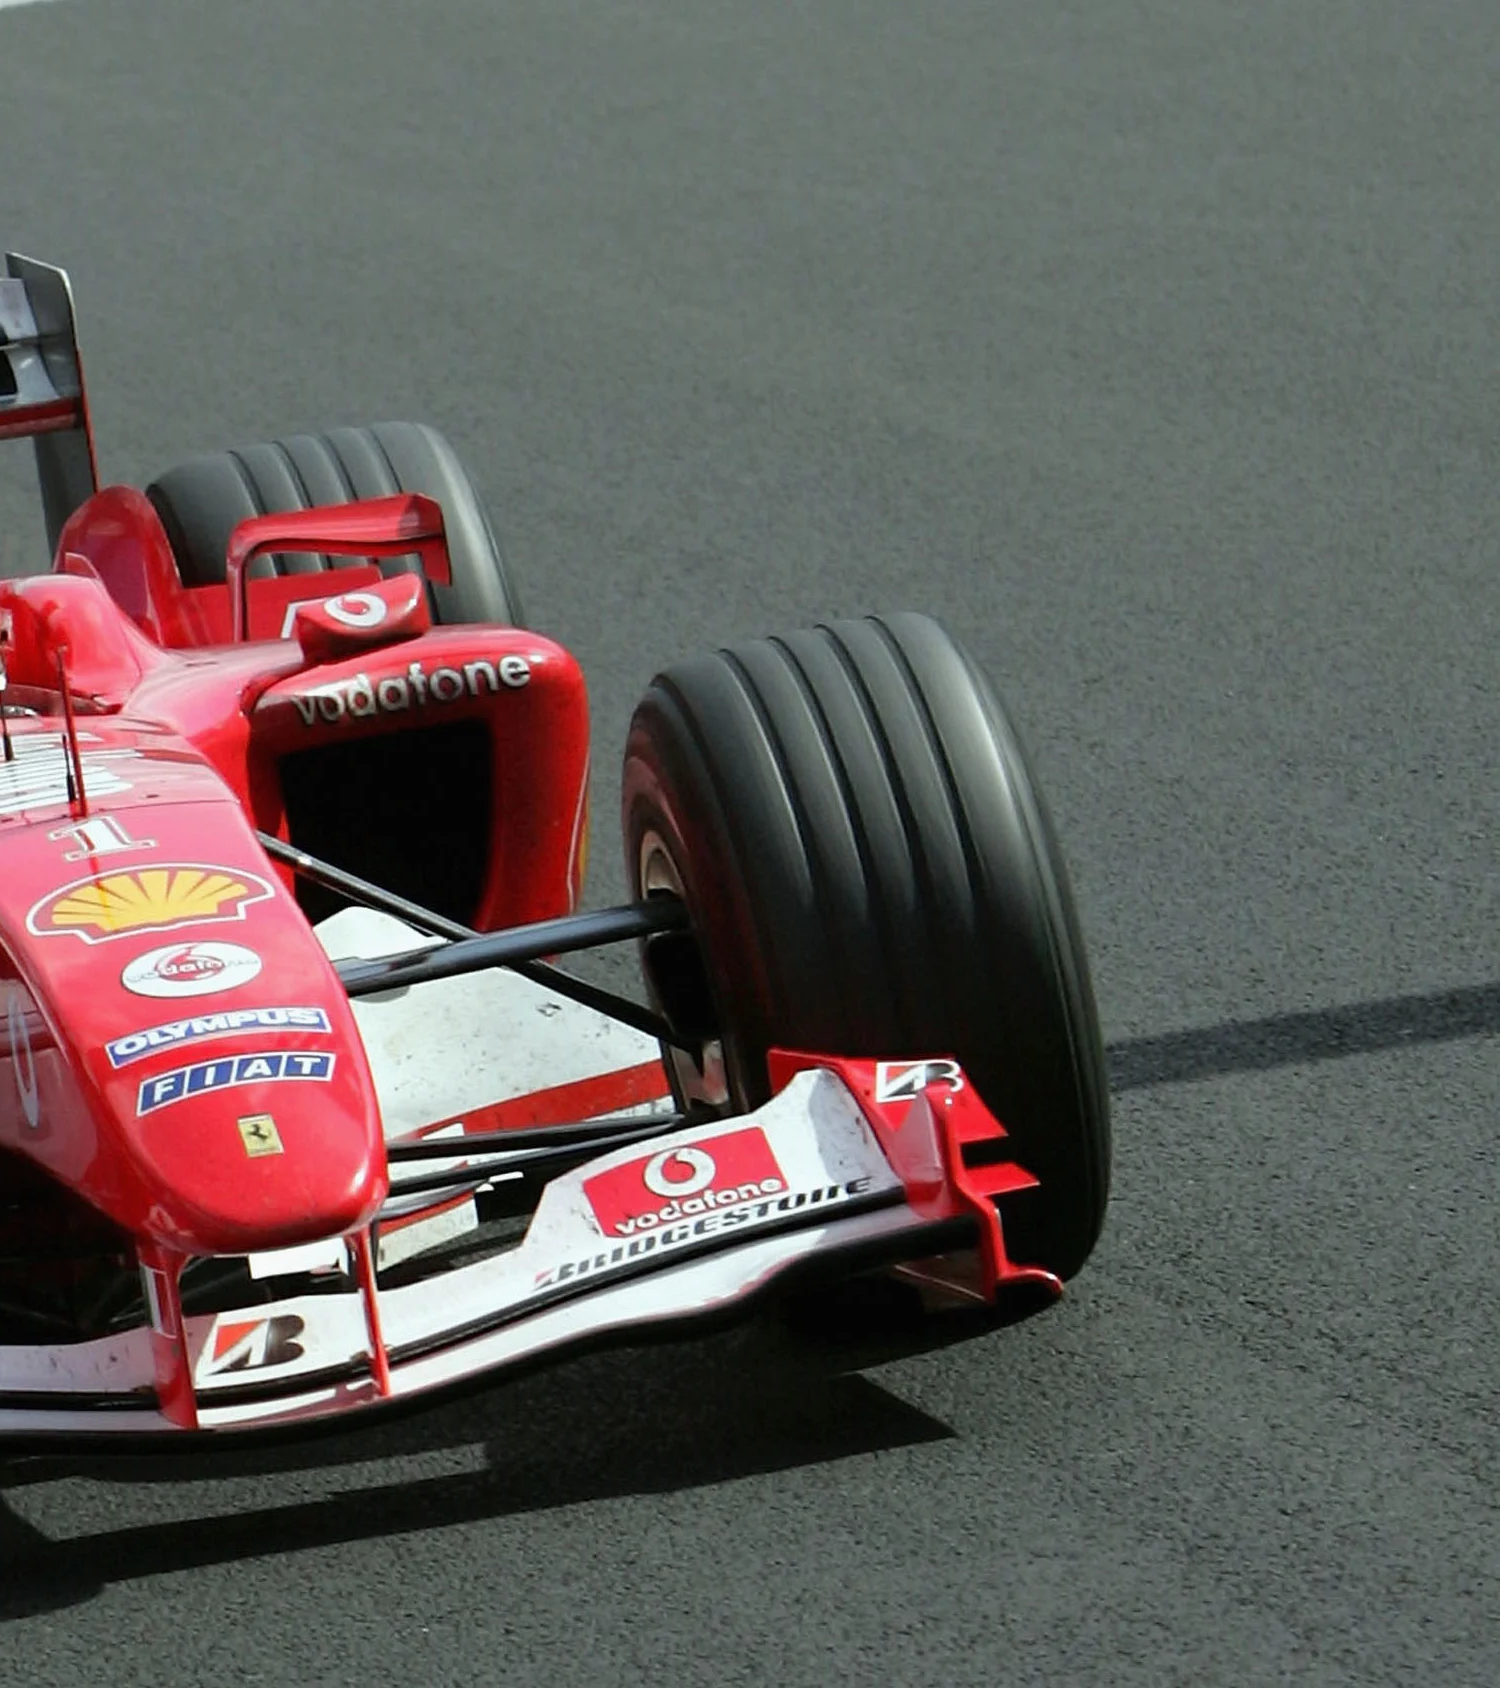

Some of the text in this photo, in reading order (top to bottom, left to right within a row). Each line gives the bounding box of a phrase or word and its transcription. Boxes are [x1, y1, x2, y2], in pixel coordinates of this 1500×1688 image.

[290, 655, 531, 725] vodafone
[49, 815, 157, 861] 1
[113, 1007, 320, 1057] OLYMPUS
[153, 1056, 322, 1104] FIAT
[534, 1176, 874, 1289] BRIDGESTONE
[614, 1176, 784, 1236] vodafone
